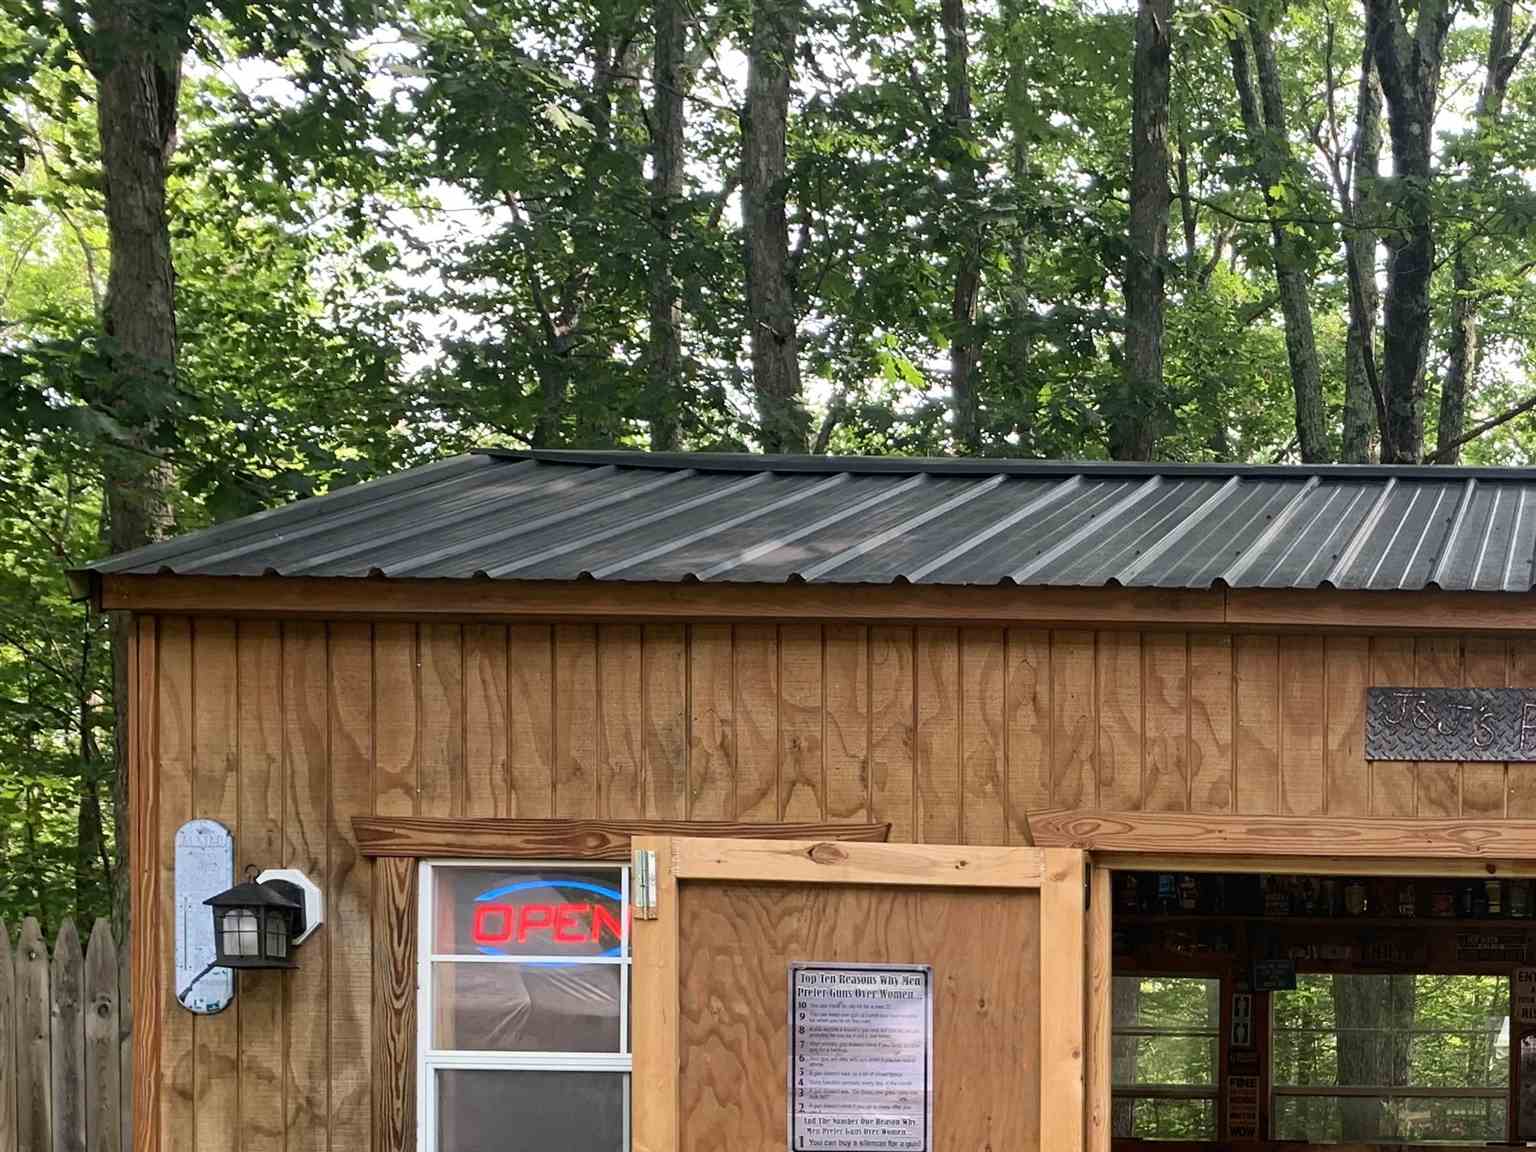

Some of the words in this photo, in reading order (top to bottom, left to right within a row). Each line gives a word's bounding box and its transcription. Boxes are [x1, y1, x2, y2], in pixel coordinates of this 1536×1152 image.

[472, 902, 632, 944] OPEN
[800, 974, 817, 985] Top
[820, 974, 836, 984] Ten
[839, 974, 877, 985] Reasons
[880, 975, 898, 986] Why
[902, 975, 921, 986] Men
[798, 988, 826, 998] Prefer
[829, 989, 853, 998] Guns
[855, 989, 877, 999] Over
